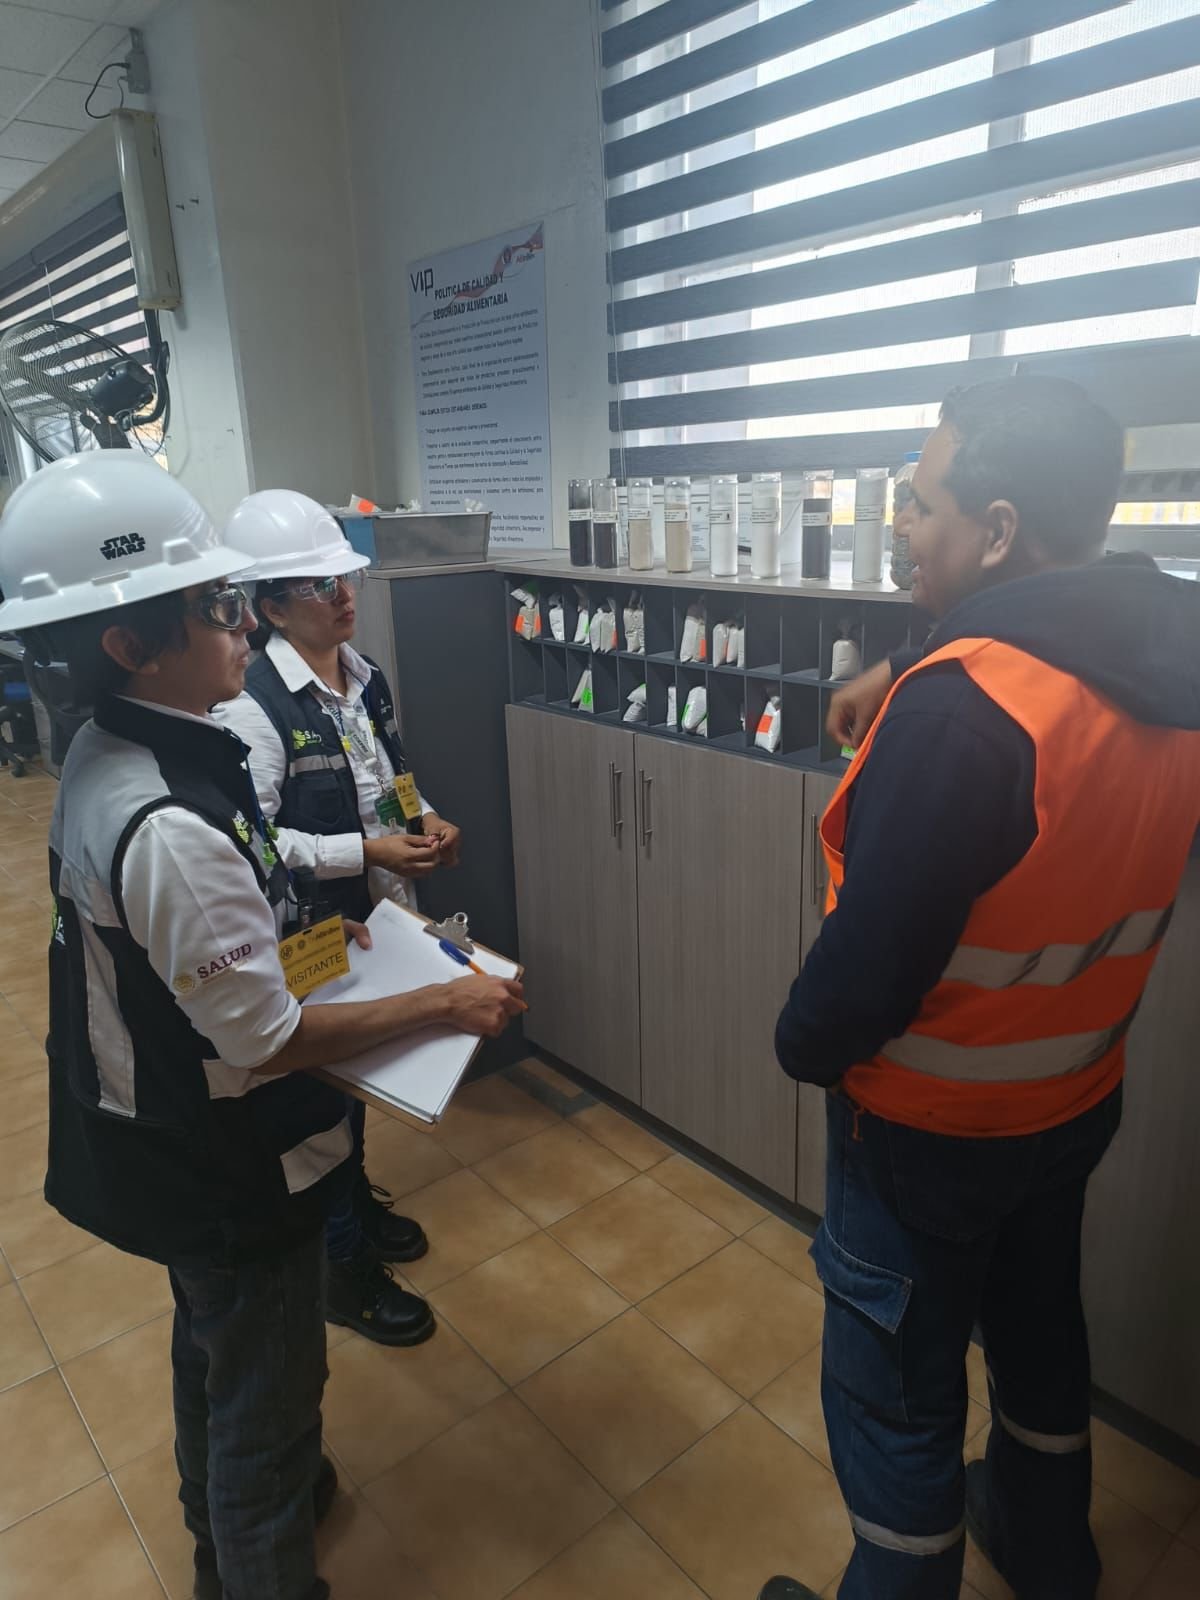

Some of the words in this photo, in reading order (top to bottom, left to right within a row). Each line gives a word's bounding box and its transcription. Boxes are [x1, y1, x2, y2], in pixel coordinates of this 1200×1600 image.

[461, 280, 471, 293] DE
[471, 273, 498, 291] CALIDAD
[498, 271, 504, 284] Y
[433, 303, 466, 320] SEGURIDAD
[466, 292, 508, 312] ALIMENTARIA
[100, 533, 145, 551] STAR
[101, 541, 146, 560] WARS
[197, 943, 252, 979] SALUD
[286, 951, 344, 988] VISITANTE
